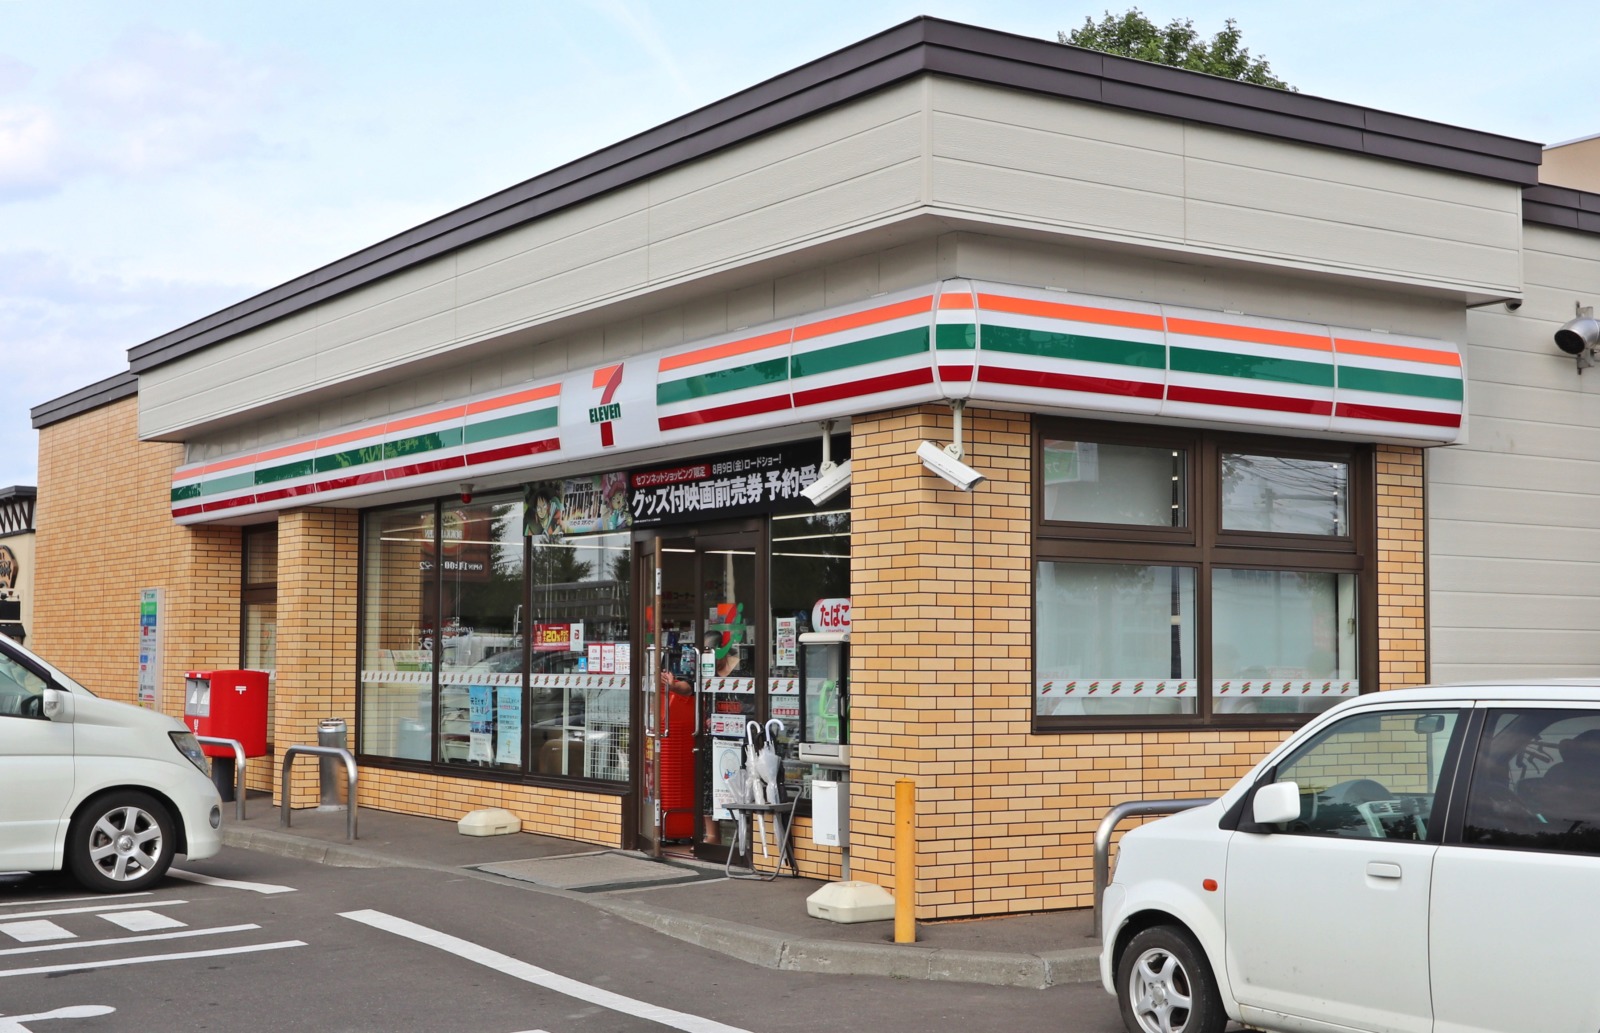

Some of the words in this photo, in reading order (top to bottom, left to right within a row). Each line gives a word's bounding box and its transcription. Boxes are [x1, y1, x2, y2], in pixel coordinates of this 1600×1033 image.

[592, 362, 624, 447] 7
[632, 464, 821, 518] グッズ付映画前売券予約受
[635, 466, 706, 486] セブンネットショッピング限定
[820, 603, 850, 627] たばこ
